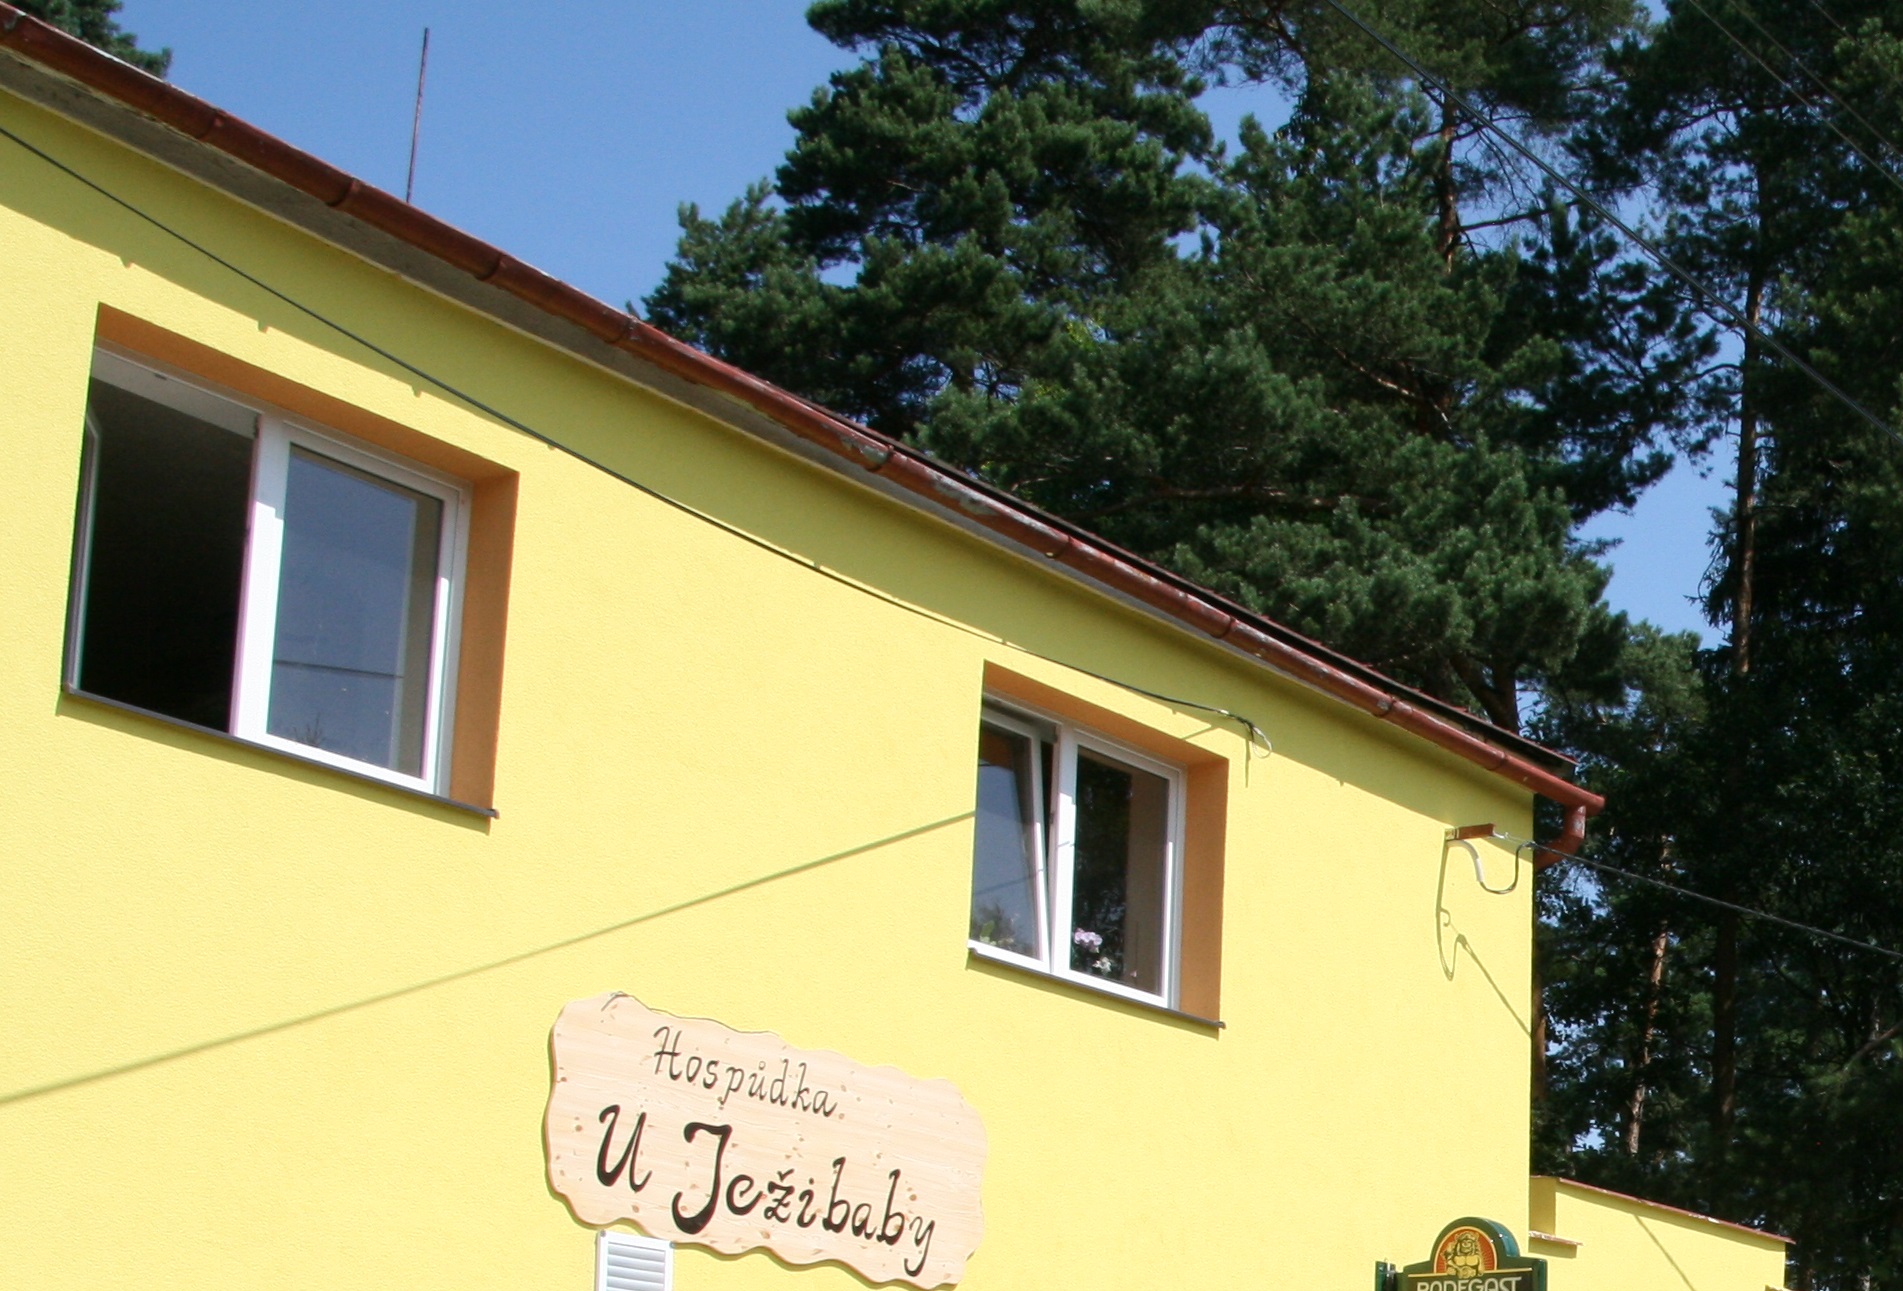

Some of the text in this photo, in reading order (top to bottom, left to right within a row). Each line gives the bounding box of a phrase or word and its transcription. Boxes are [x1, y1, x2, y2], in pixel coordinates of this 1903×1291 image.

[652, 1025, 838, 1118] Hospůdka
[596, 1104, 936, 1278] U Ježibaby
